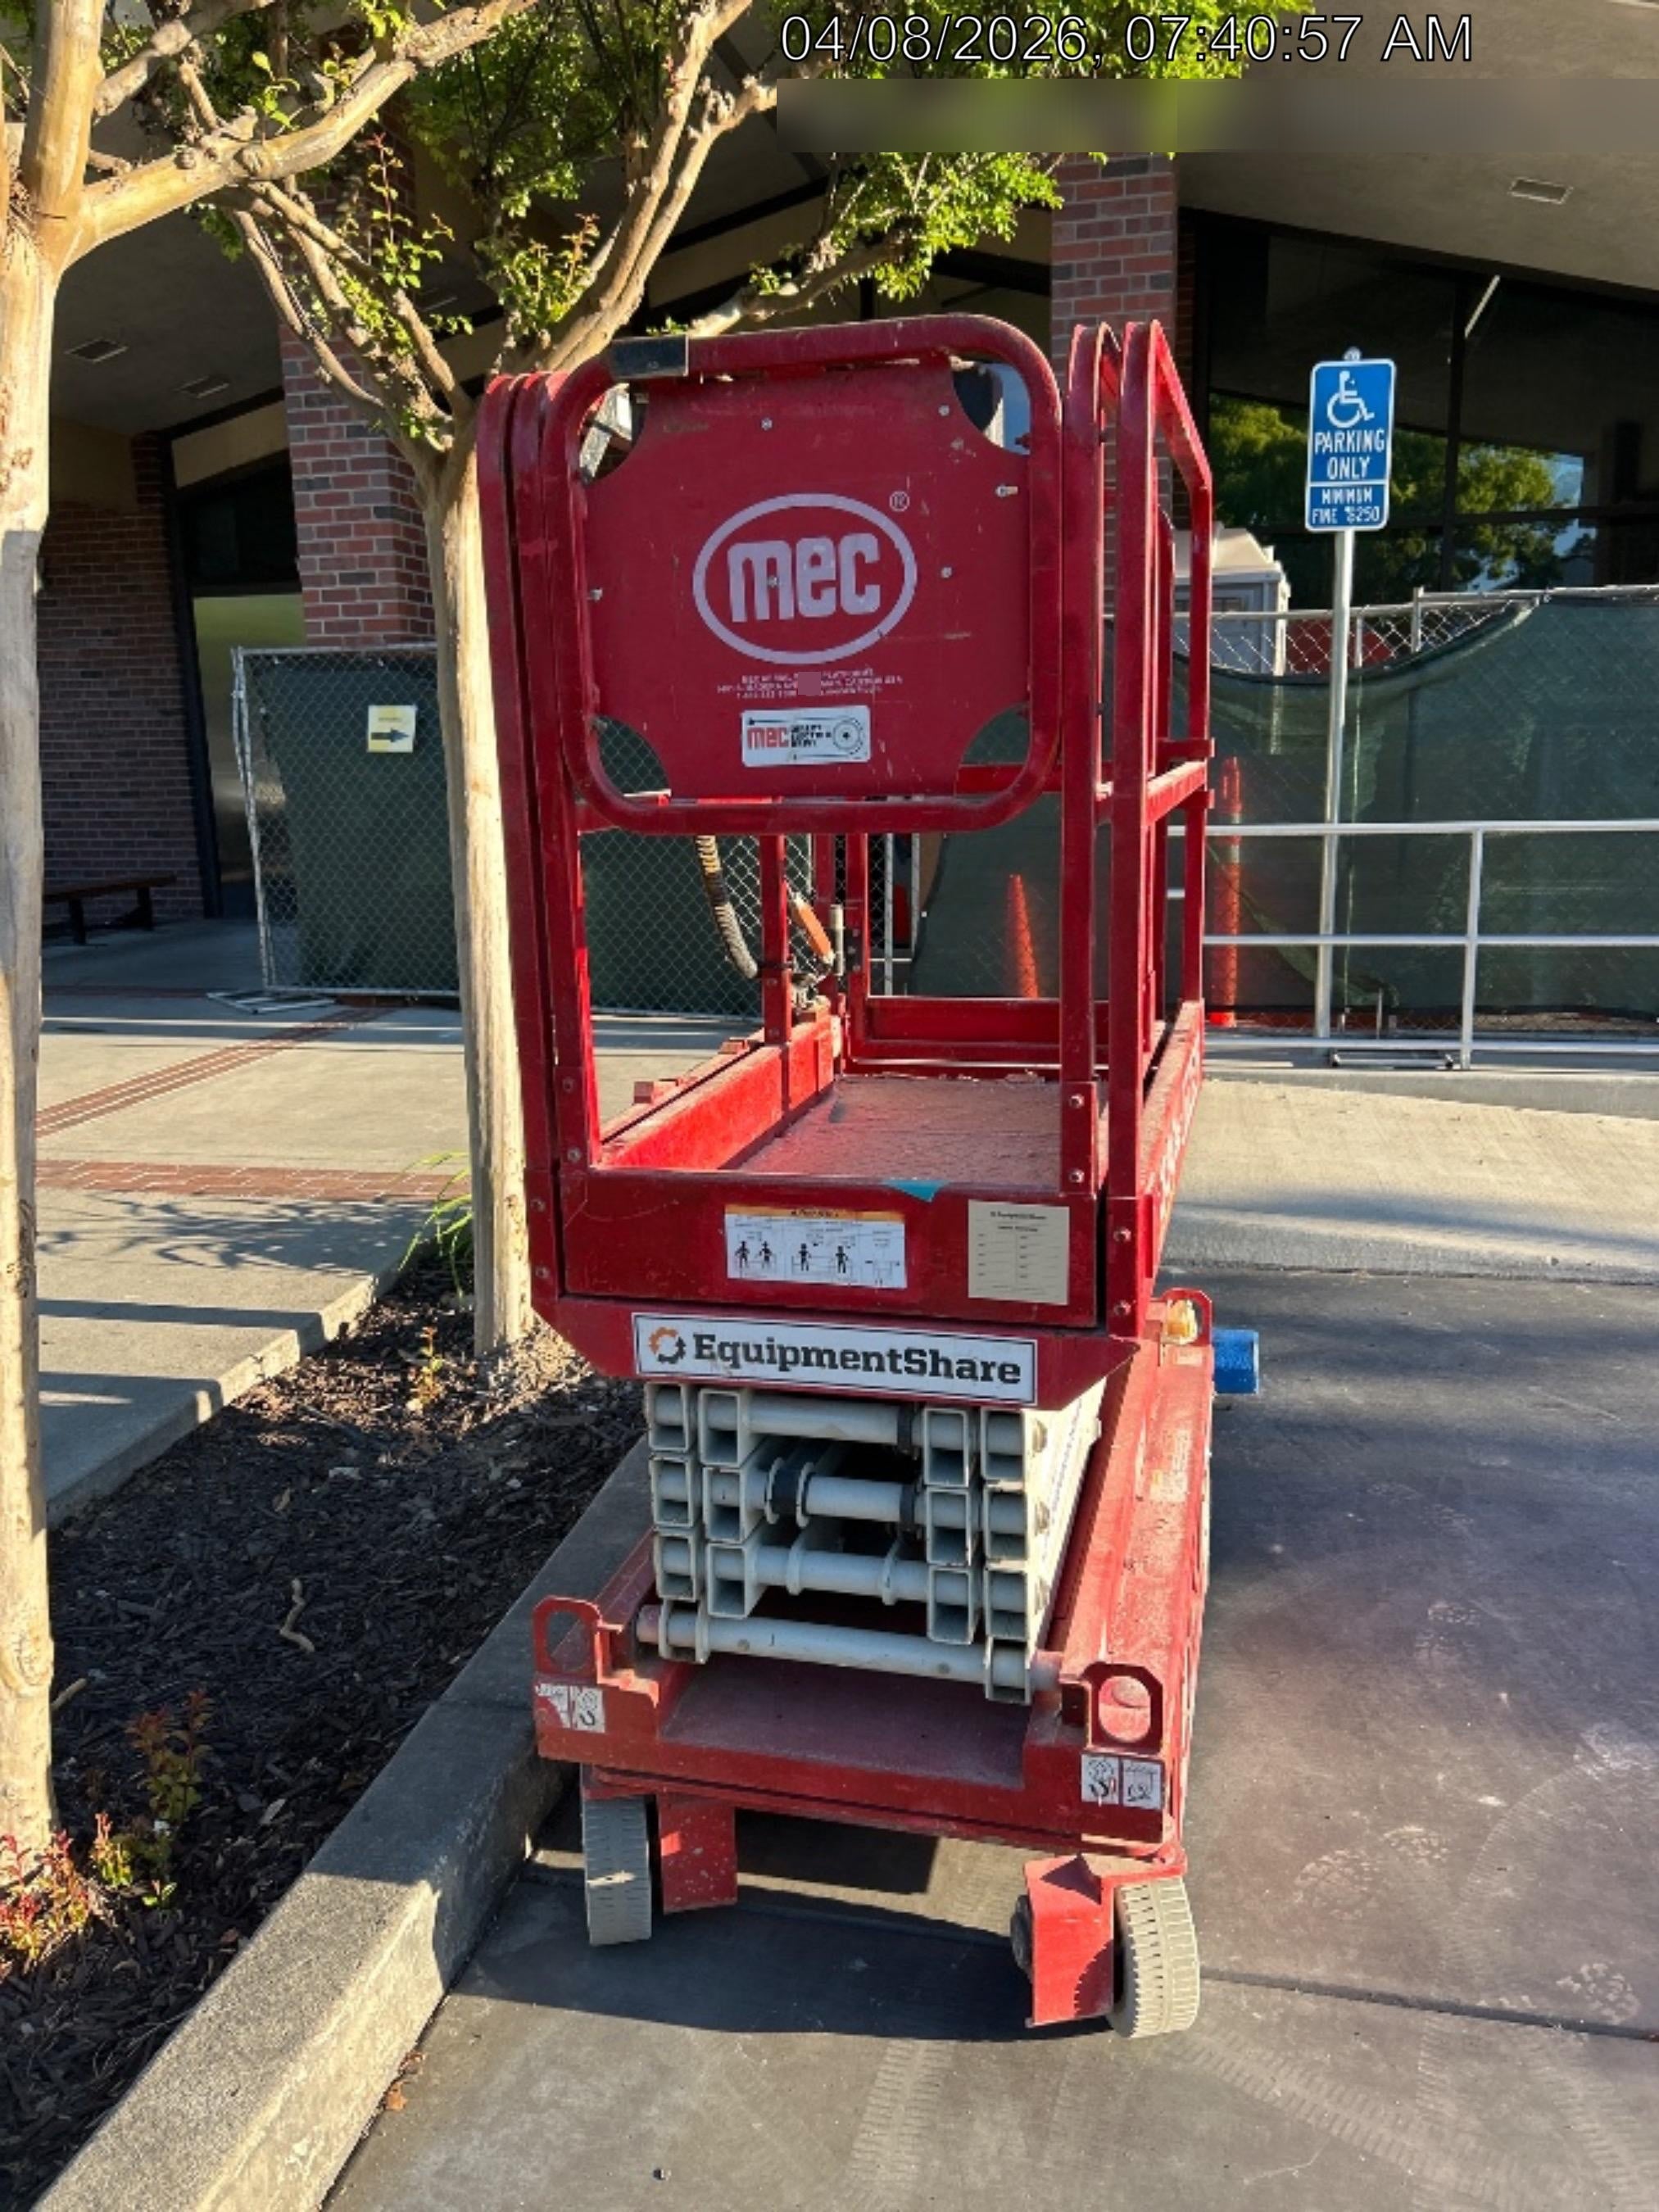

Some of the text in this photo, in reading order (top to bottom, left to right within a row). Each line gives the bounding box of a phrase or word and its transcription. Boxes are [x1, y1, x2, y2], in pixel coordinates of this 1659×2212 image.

[1315, 428, 1385, 453] PARKING
[1327, 456, 1370, 479] ONLY
[1312, 508, 1338, 524] FINE
[693, 1333, 1022, 1385] EquipmentShare
